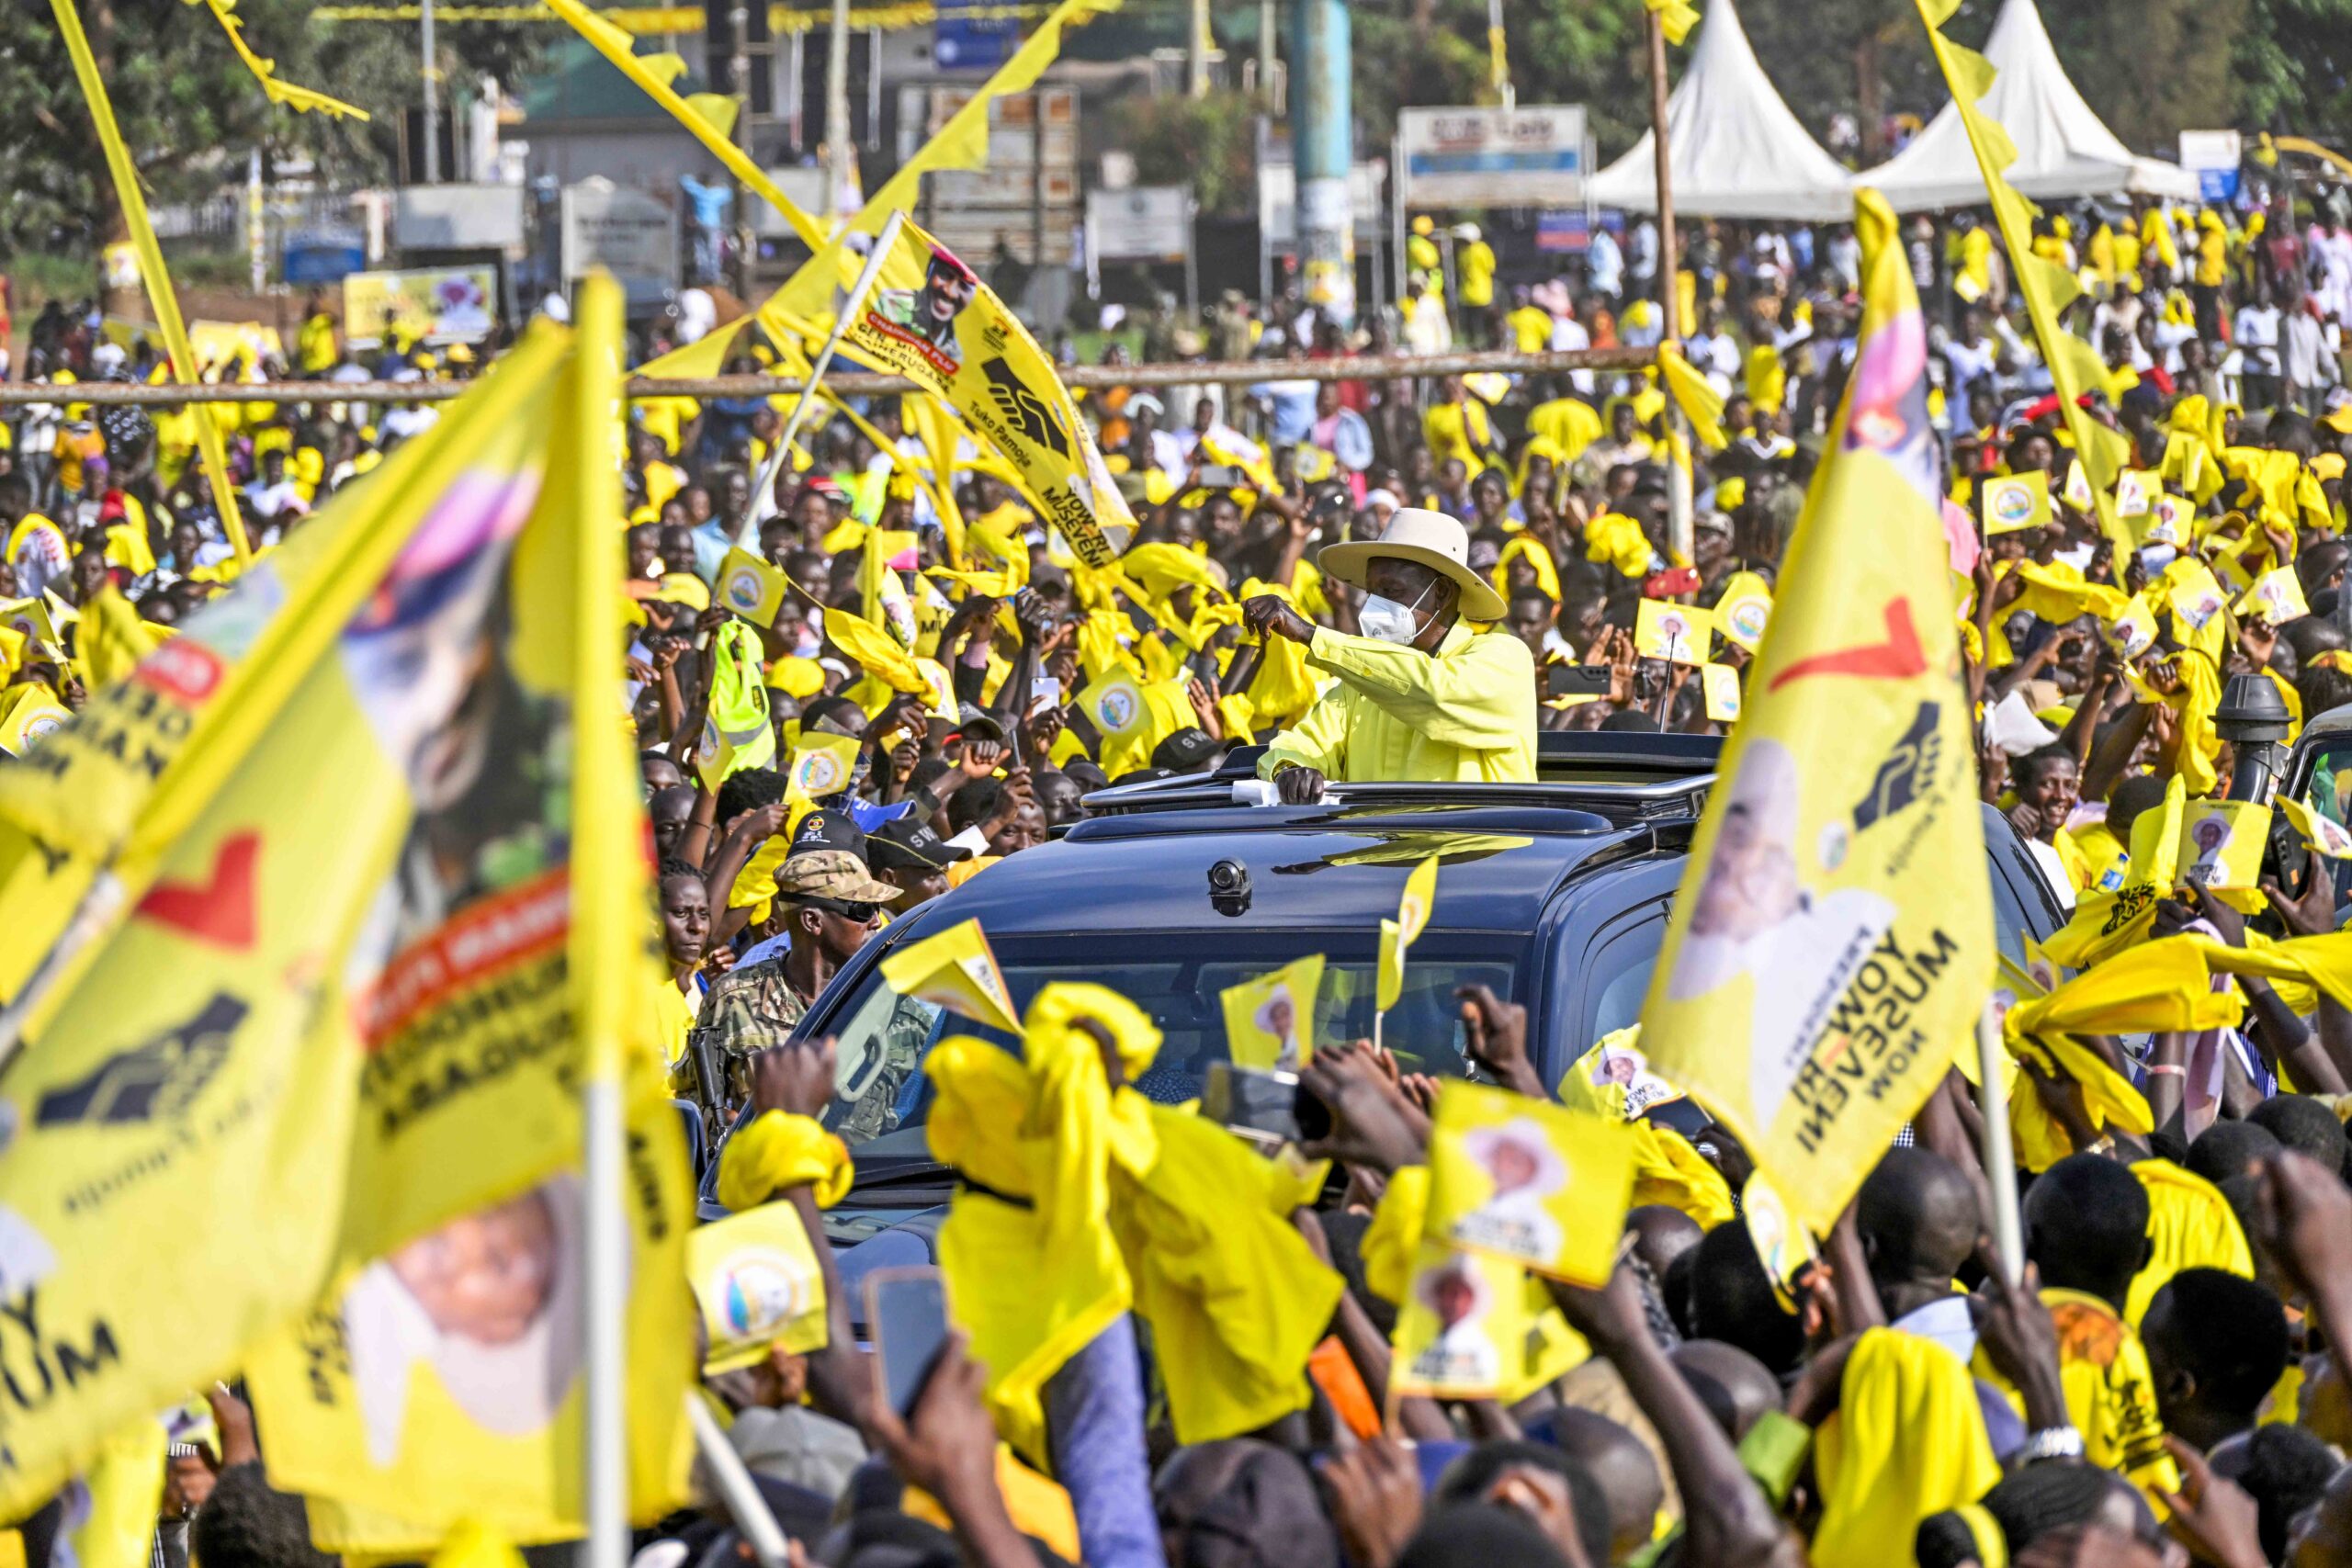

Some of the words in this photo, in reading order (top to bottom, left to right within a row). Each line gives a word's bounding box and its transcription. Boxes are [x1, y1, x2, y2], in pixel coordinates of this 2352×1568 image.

[970, 400, 995, 429] Tuko
[994, 424, 1032, 468] Pamoja
[1042, 487, 1105, 569] MUSEVENI
